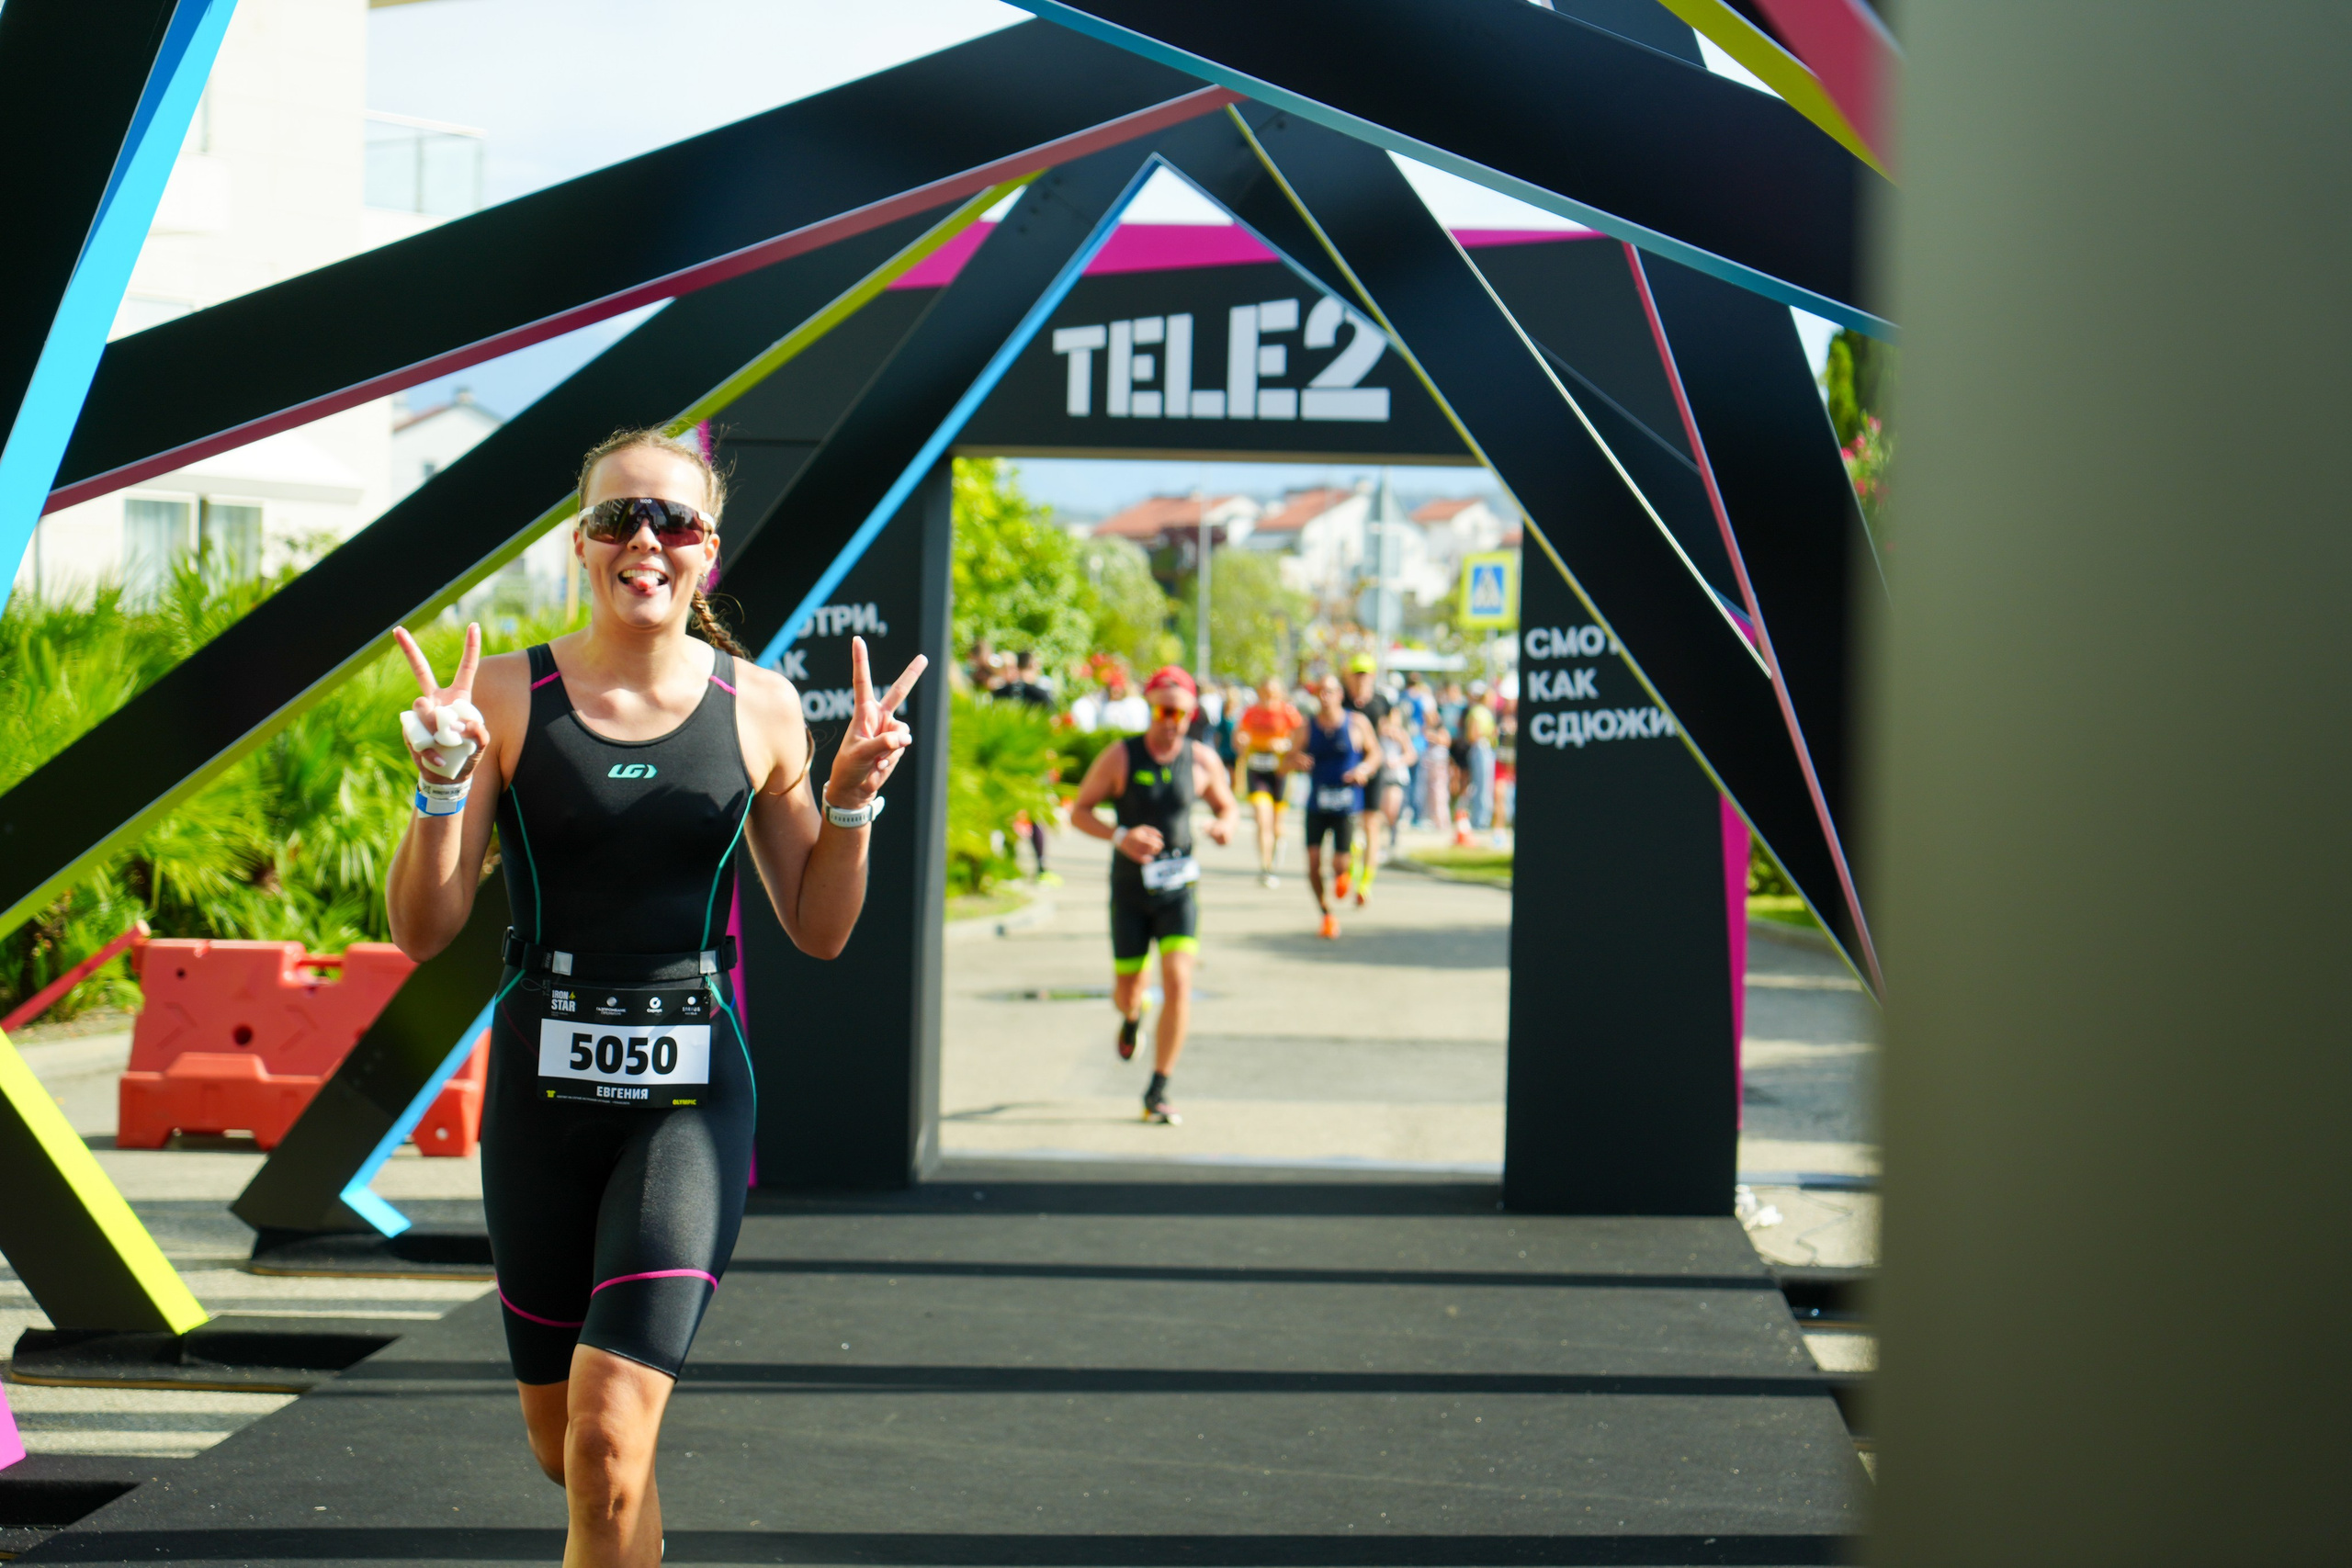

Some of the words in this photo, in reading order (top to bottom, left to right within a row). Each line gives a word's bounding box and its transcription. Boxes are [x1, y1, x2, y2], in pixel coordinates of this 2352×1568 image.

[1052, 294, 1390, 423] TELE2
[1527, 667, 1600, 703] КАК
[1529, 706, 1679, 750] СДЮЖИ
[551, 989, 569, 999] IRON
[551, 998, 576, 1012] STAR
[569, 1032, 678, 1076] 5050
[596, 1086, 649, 1100] ЕВГЕНИЯ
